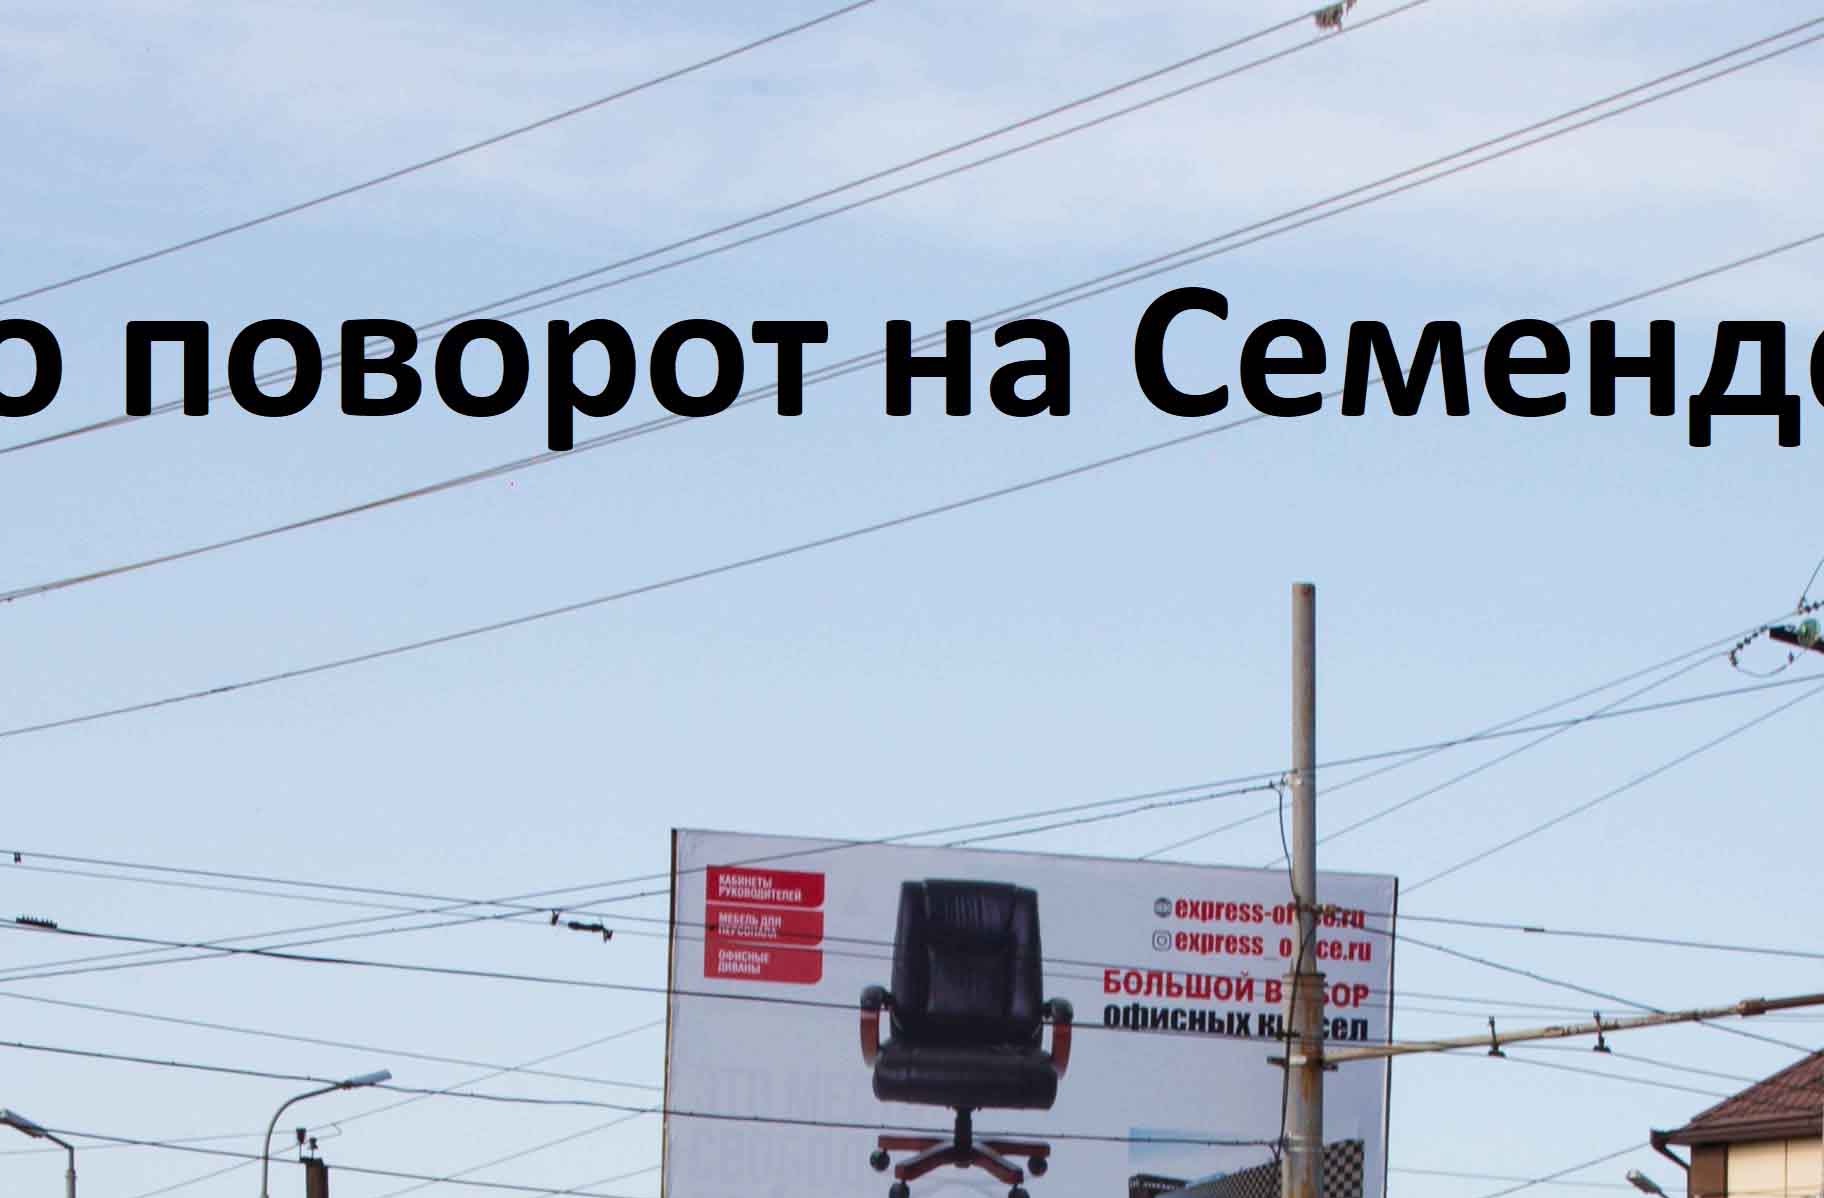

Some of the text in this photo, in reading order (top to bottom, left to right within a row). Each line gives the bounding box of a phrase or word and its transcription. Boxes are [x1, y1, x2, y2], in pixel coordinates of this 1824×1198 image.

[1175, 898, 1365, 929] express-ofe.ru
[1175, 931, 1372, 962] express_oce.ru
[1102, 968, 1254, 1003] БОЛЬШОЙ
[1103, 1003, 1251, 1037] офисных
